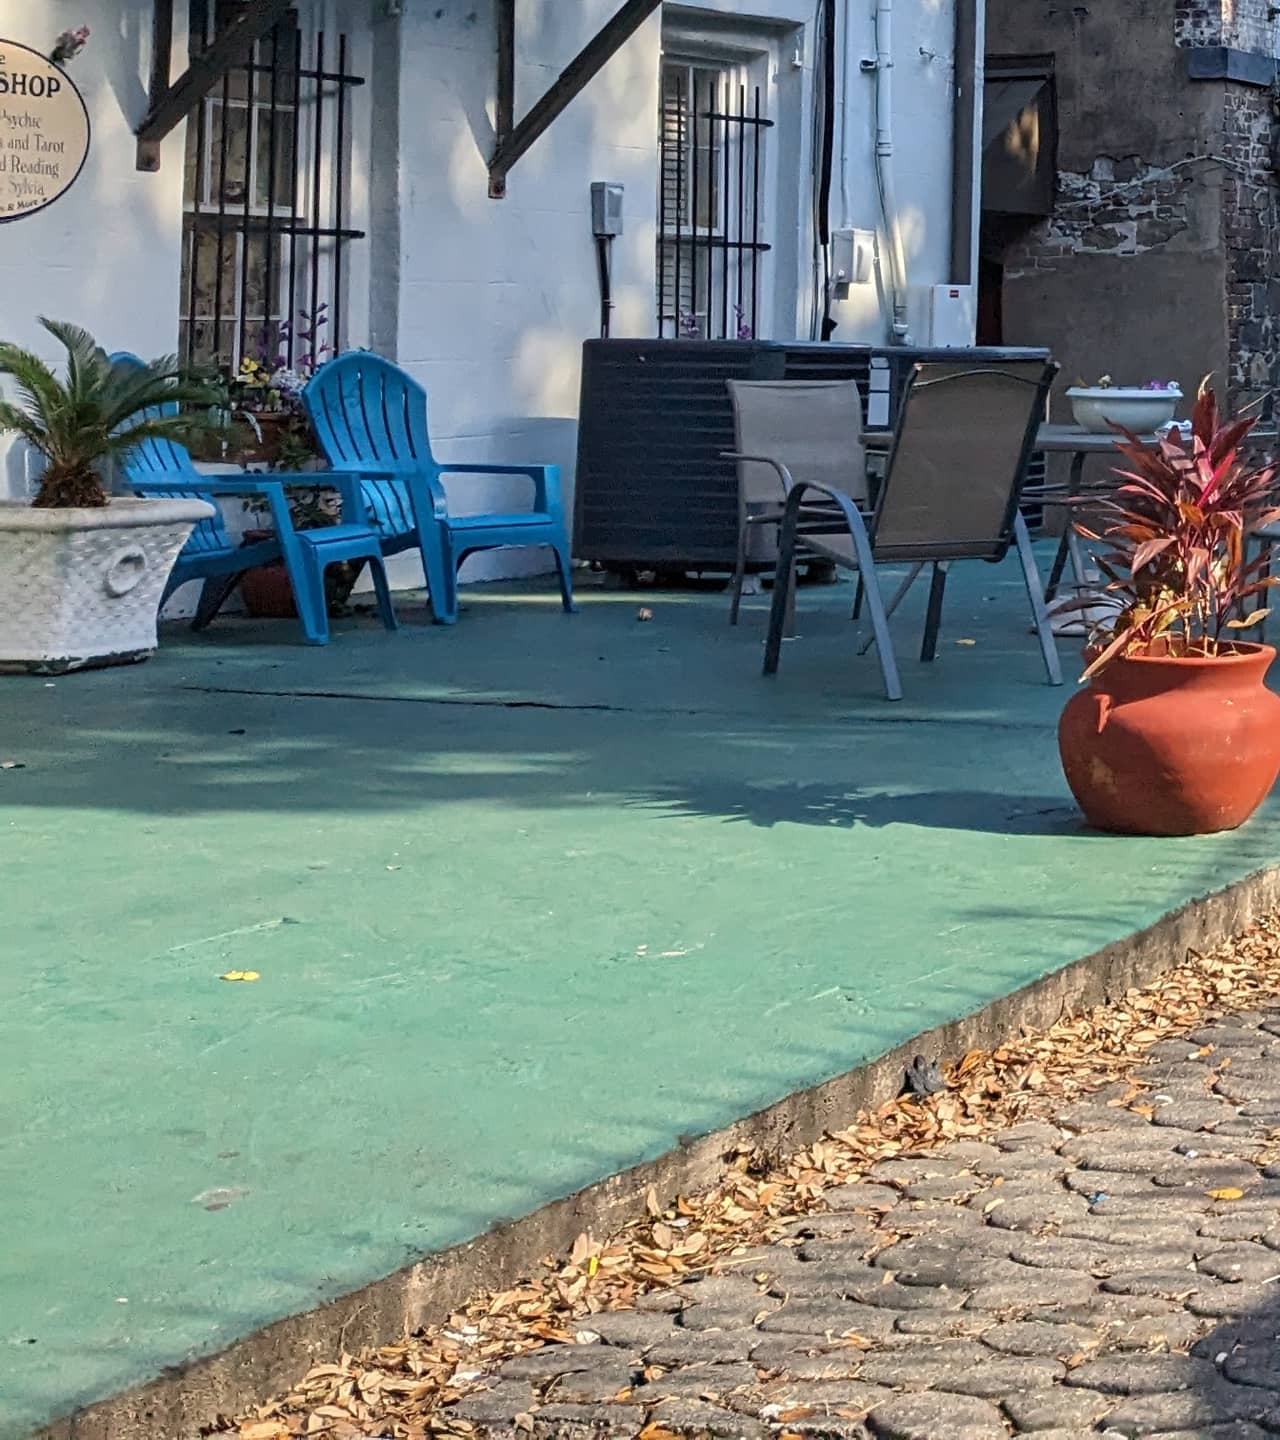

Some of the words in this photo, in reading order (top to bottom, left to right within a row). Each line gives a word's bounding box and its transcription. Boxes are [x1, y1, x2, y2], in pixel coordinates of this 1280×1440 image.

[0, 71, 61, 99] SHOP
[8, 133, 29, 151] and
[33, 133, 65, 154] Tarot
[11, 154, 60, 179] Reading
[8, 177, 45, 198] Sylvia
